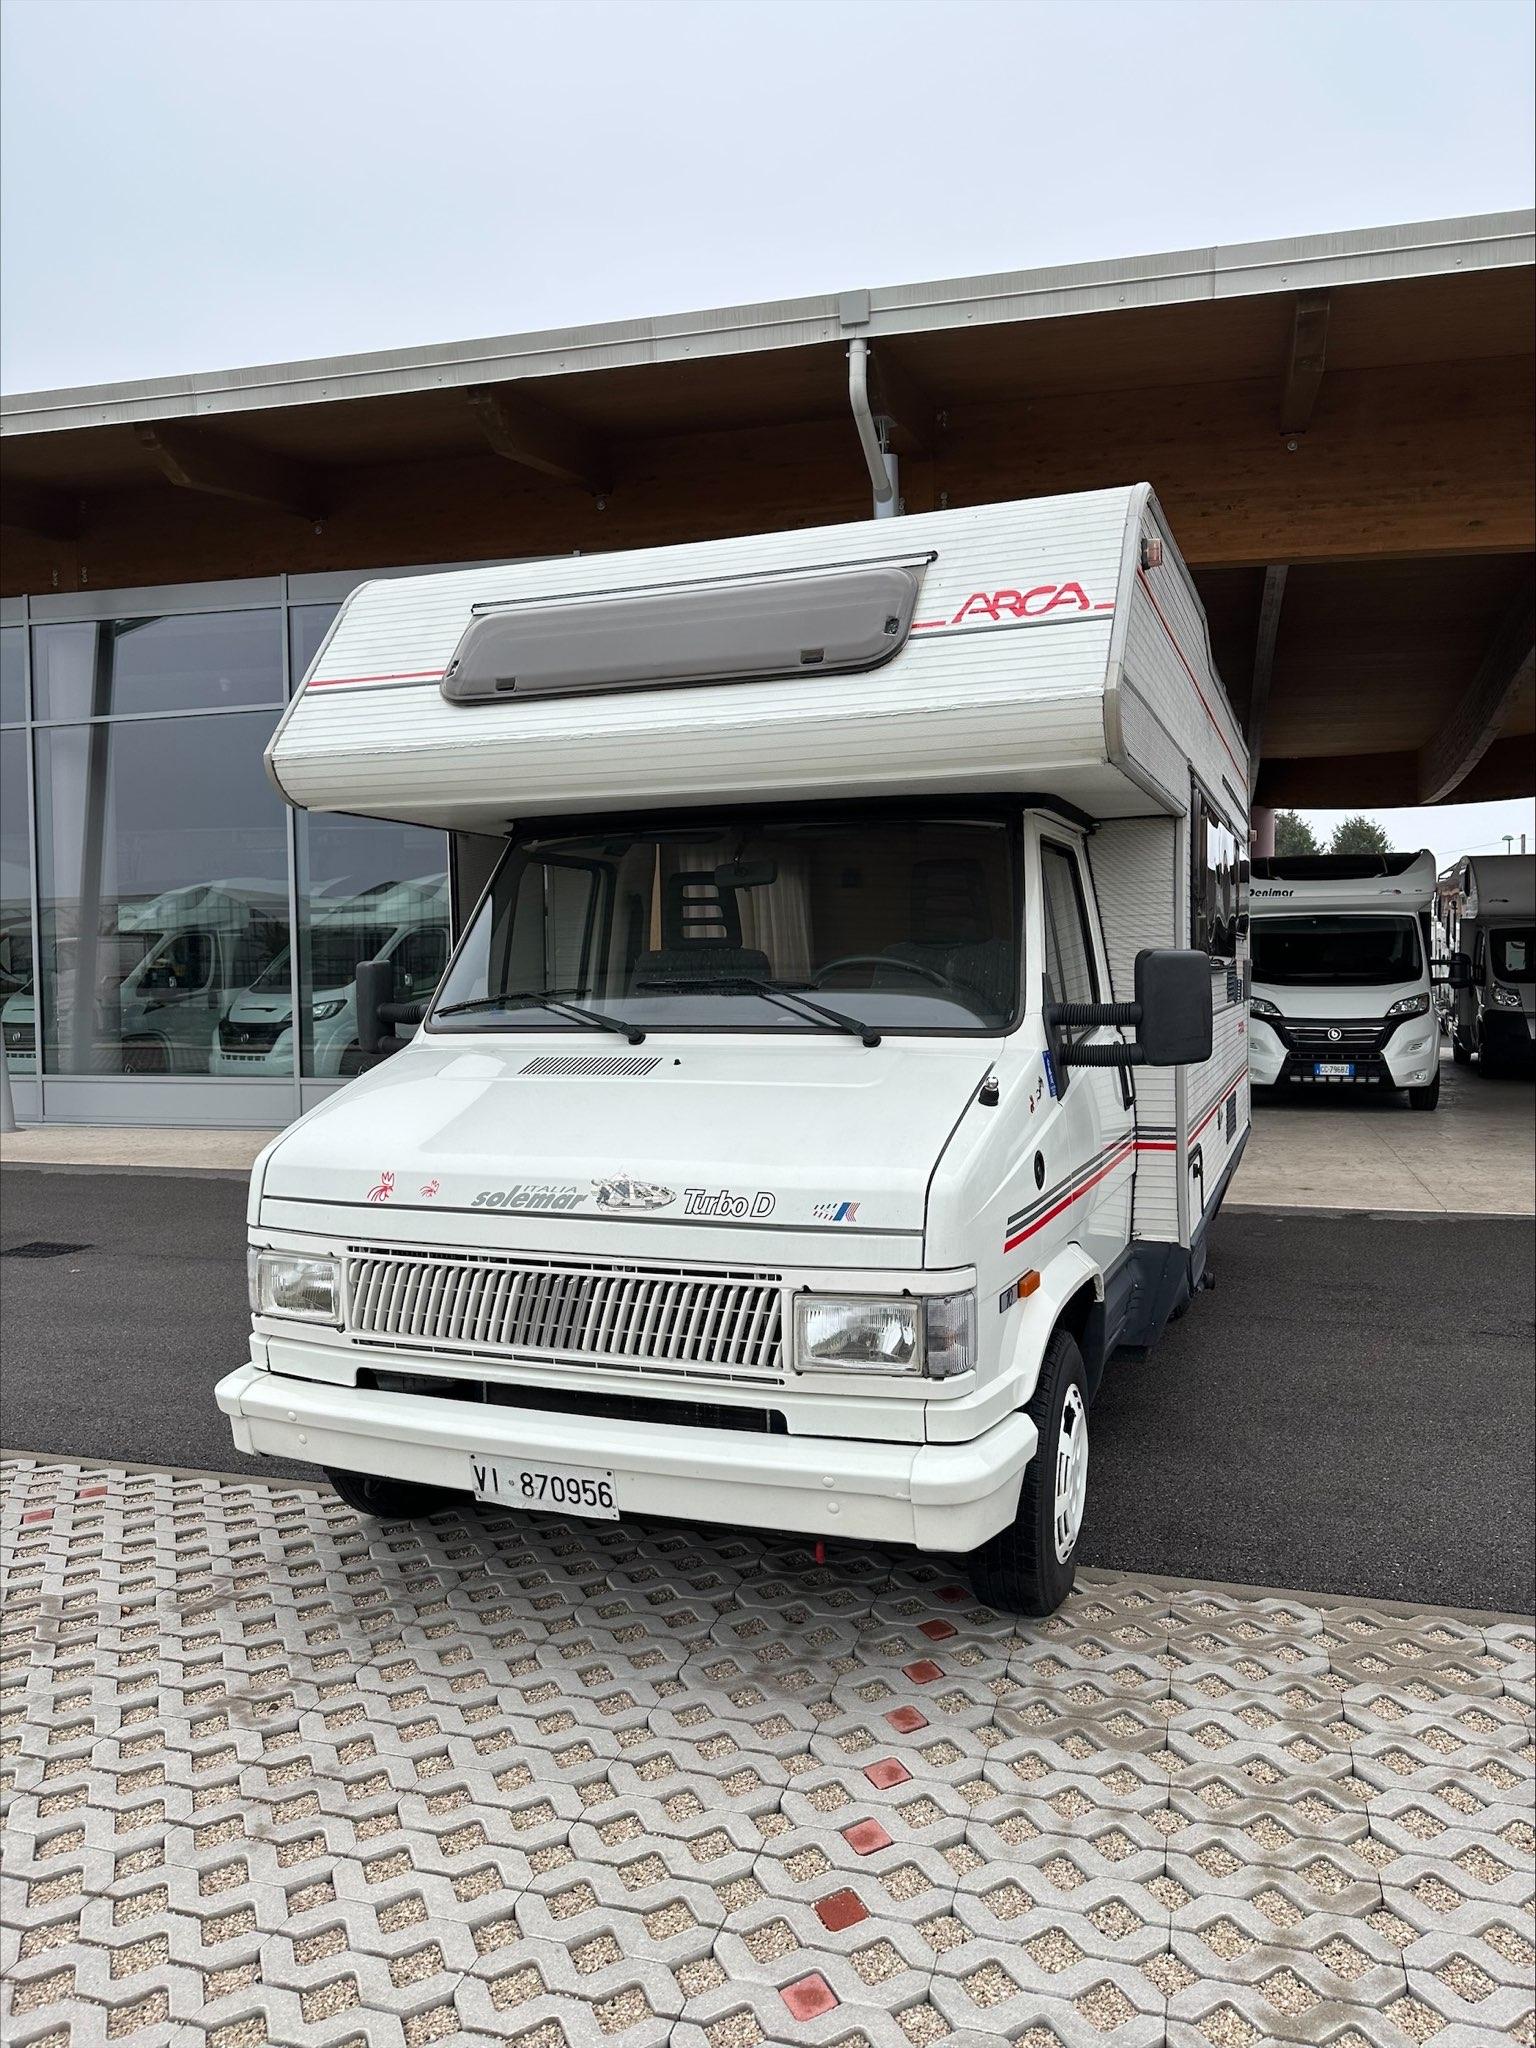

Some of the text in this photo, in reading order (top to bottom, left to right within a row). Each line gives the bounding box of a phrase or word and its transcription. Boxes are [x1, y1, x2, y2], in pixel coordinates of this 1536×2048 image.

[952, 582, 1090, 624] ARCA
[470, 1185, 588, 1210] solemar
[522, 1185, 578, 1194] ITALIA
[684, 1189, 776, 1218] Turbo D
[473, 1465, 613, 1509] VI 870956
